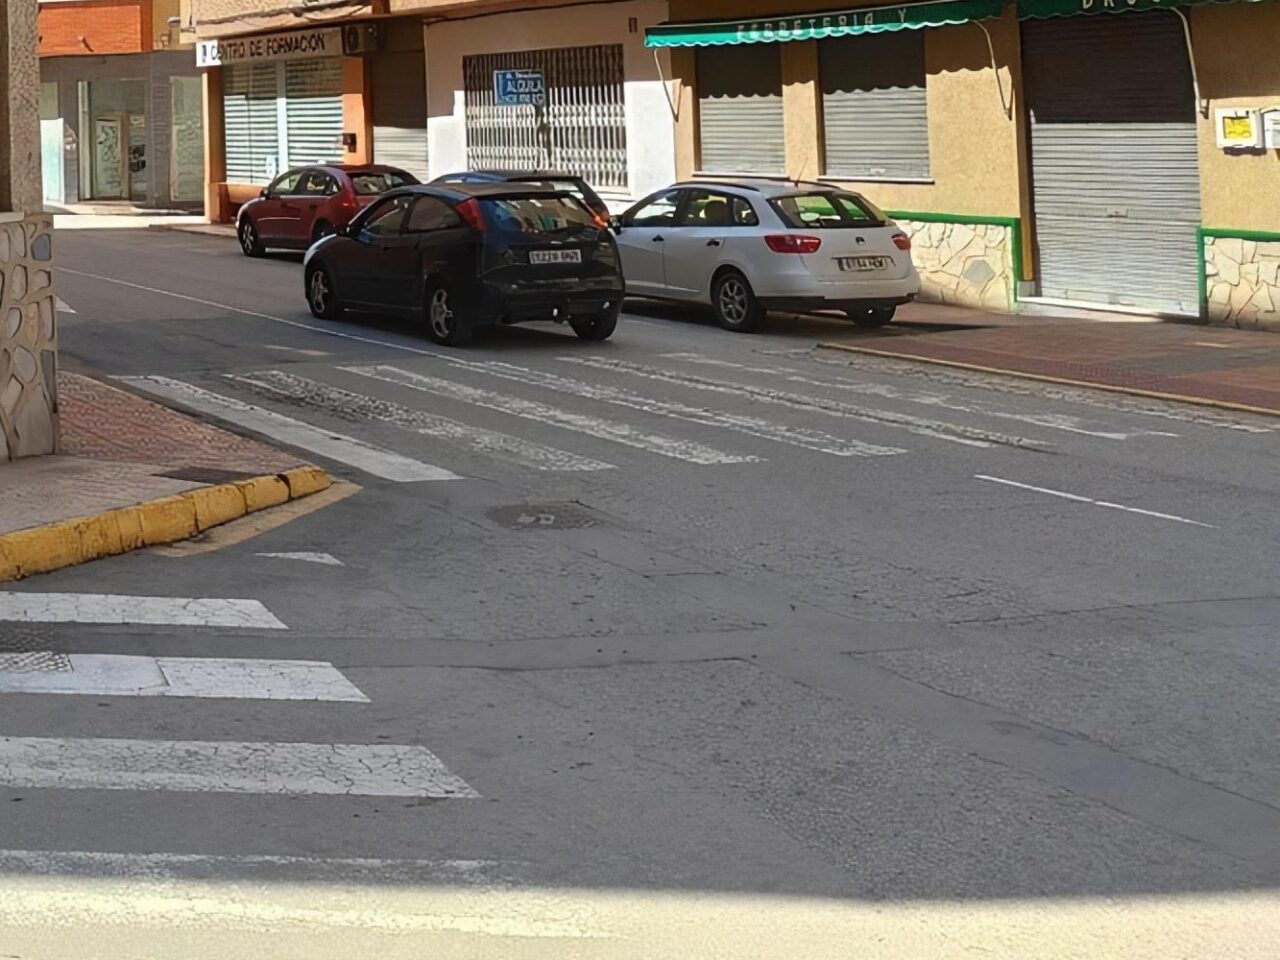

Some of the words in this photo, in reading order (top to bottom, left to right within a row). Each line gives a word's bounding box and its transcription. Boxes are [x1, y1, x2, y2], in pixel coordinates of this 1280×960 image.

[736, 12, 874, 40] FERRETERIA
[897, 7, 908, 24] Y
[210, 40, 246, 60] CENTRO
[249, 39, 264, 57] DE
